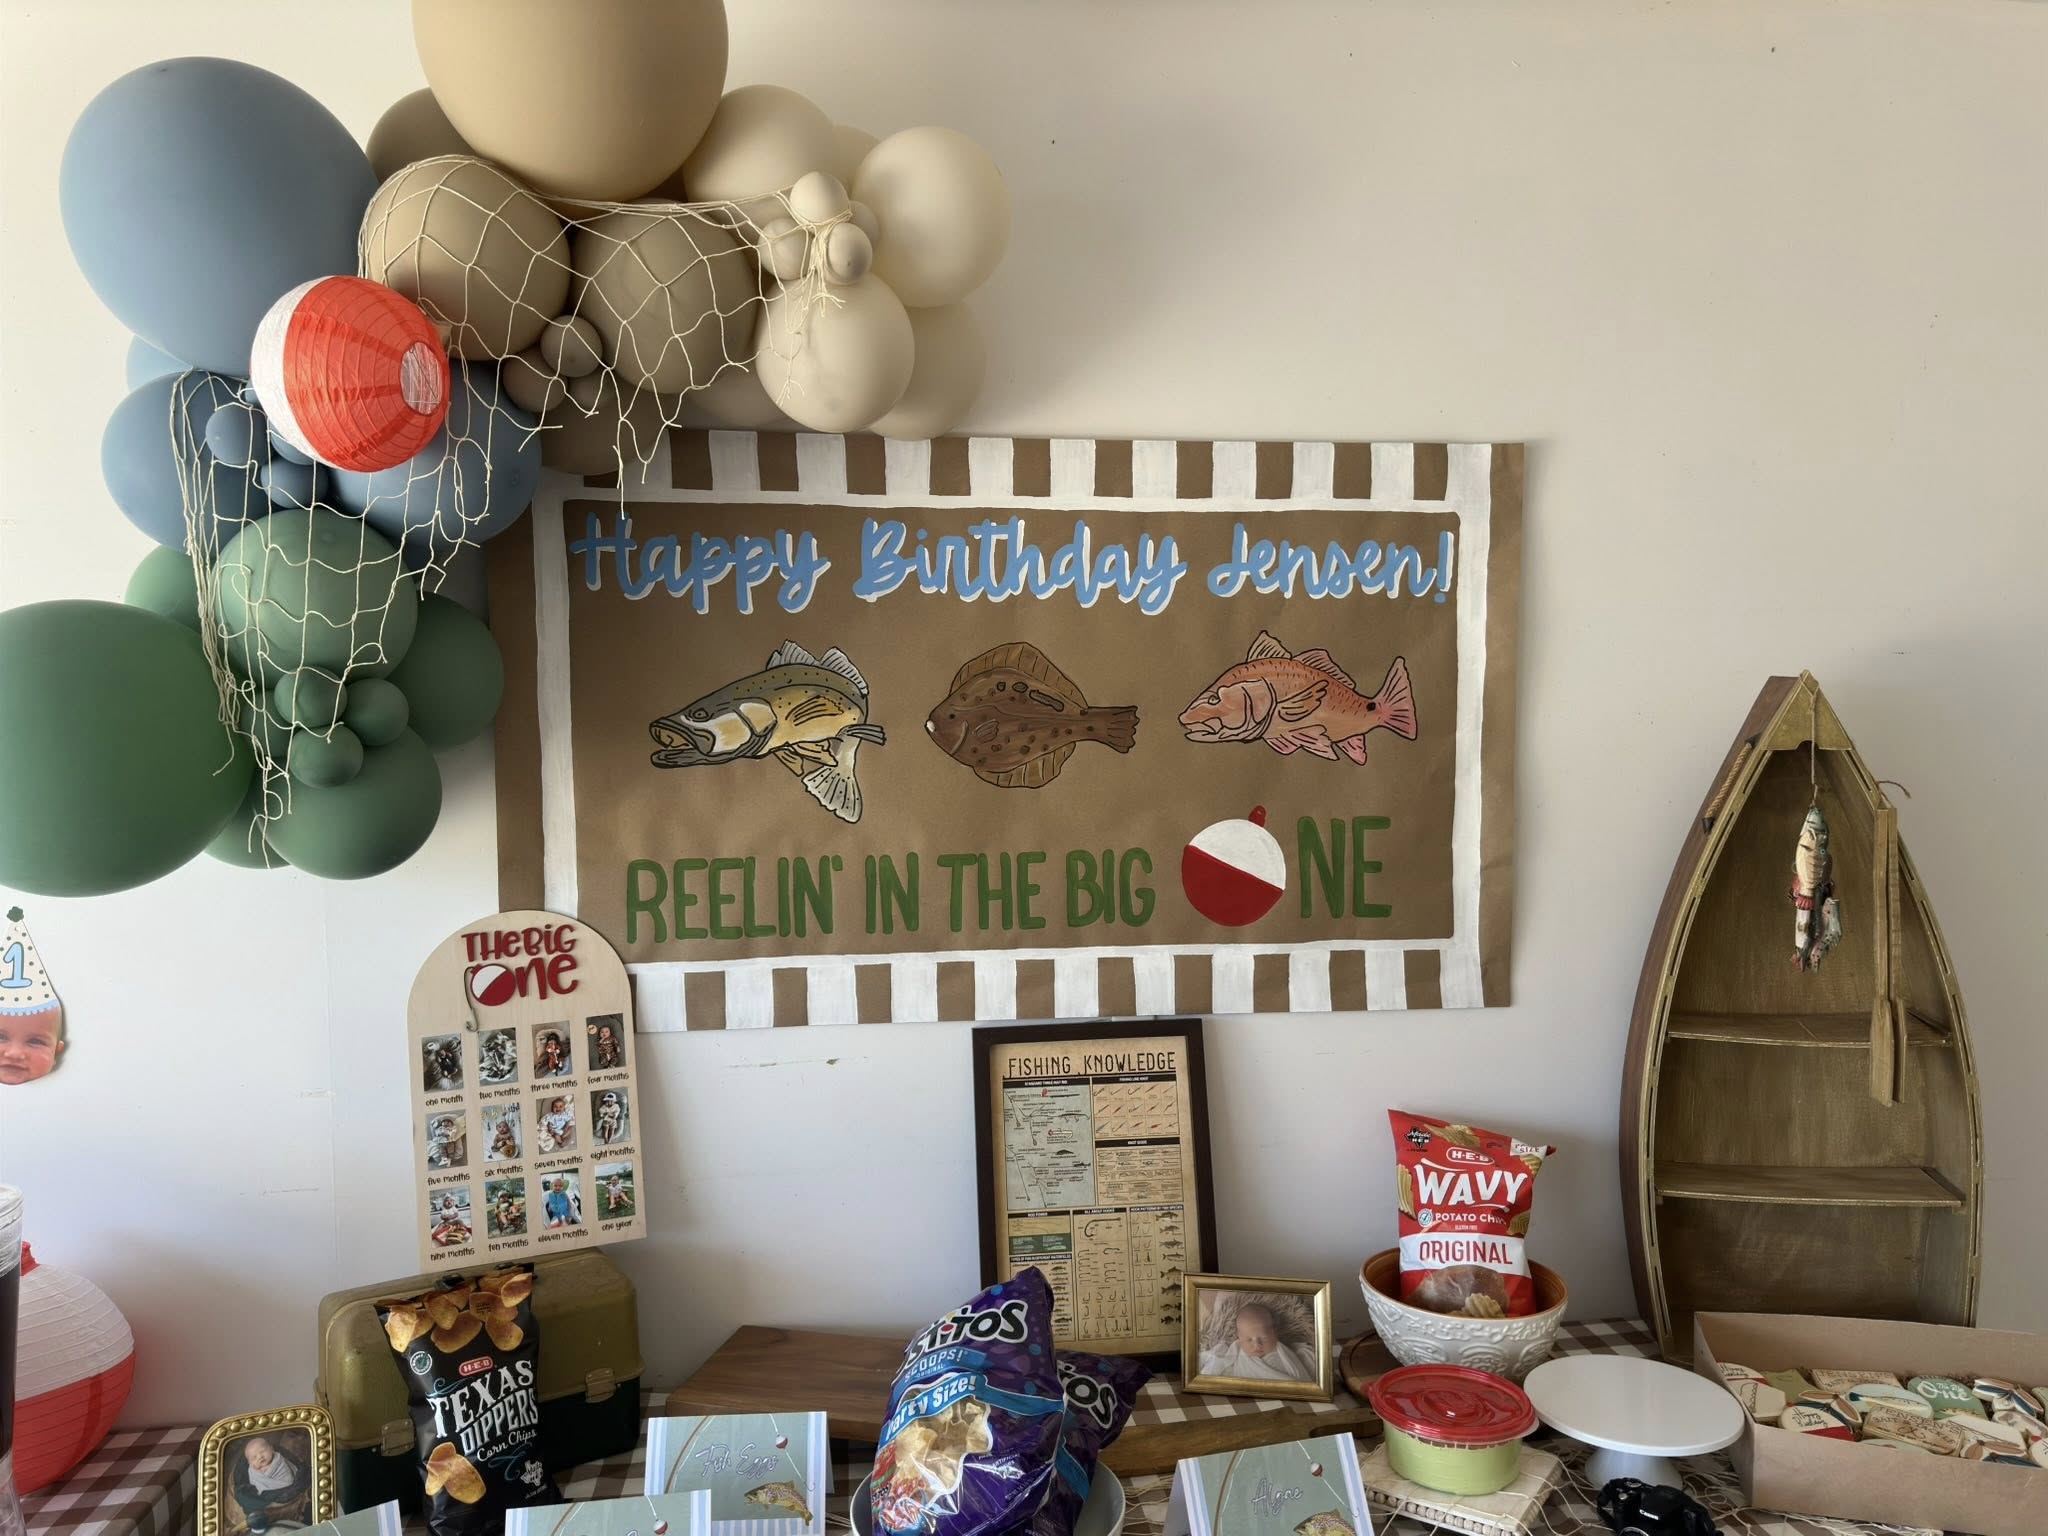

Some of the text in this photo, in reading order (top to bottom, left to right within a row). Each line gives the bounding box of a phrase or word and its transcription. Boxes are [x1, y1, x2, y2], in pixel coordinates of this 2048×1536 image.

[570, 511, 1454, 614] Happy Birthday Jensen!
[626, 854, 843, 944] REELIN'
[865, 851, 919, 934] IN
[937, 851, 1046, 932] THE
[1066, 847, 1156, 928] BIG
[1, 942, 33, 989] 1
[1008, 1052, 1177, 1078] FISHING KNOWLEDGE
[587, 1072, 630, 1085] four months
[479, 1087, 521, 1099] two months
[530, 1080, 578, 1093] three months
[426, 1095, 464, 1107] one month
[590, 1147, 635, 1161] eight months
[534, 1156, 583, 1170] seven months
[485, 1165, 524, 1178] six months
[428, 1172, 470, 1186] five months
[1414, 1164, 1529, 1206] WAVY
[1435, 1212, 1477, 1222] POTATO
[602, 1220, 632, 1232] one year
[538, 1229, 589, 1243] eleven months
[488, 1239, 529, 1253] ten months
[1419, 1240, 1513, 1264] ORIGINAL
[430, 1248, 475, 1261] nine months
[933, 1375, 977, 1408] Size!
[1917, 1380, 1974, 1402] One
[426, 1359, 534, 1439] TEXAS
[460, 1387, 539, 1457] DIPPERS
[477, 1428, 537, 1462] Corn Chips
